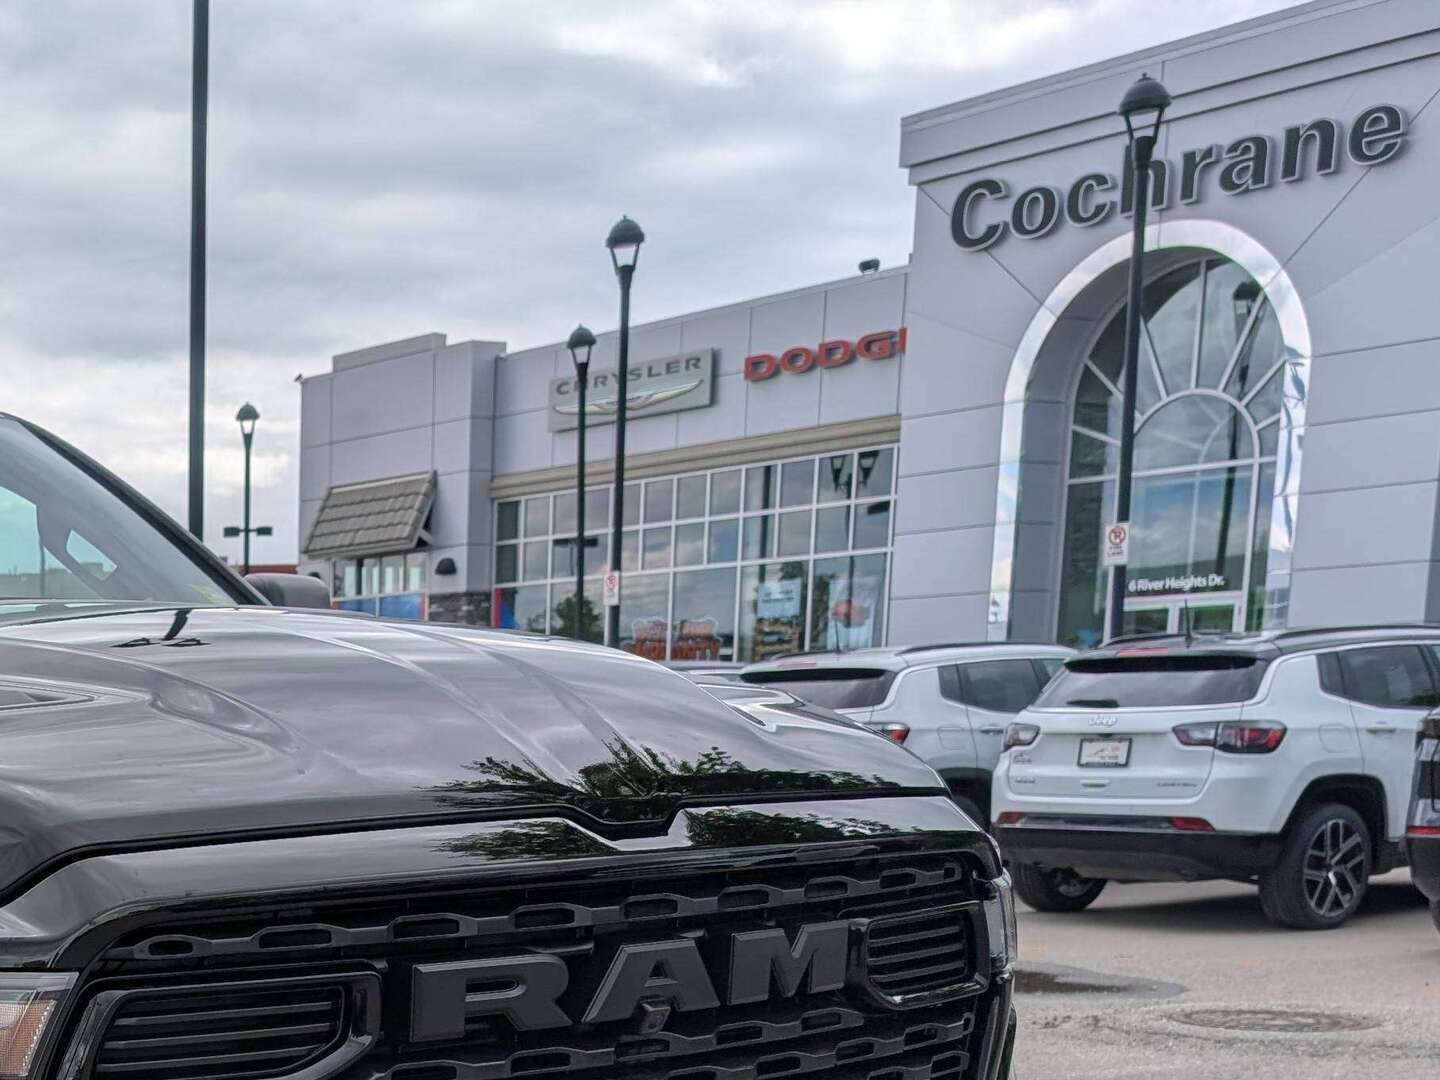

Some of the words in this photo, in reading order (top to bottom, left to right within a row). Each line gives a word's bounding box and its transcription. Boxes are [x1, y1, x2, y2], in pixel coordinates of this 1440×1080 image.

[951, 103, 1408, 252] Cochrane
[1128, 580, 1137, 592] 6
[1137, 578, 1165, 592] River
[1165, 575, 1207, 591] Heights
[1208, 573, 1225, 587] Dr.
[409, 919, 850, 1043] RAM
